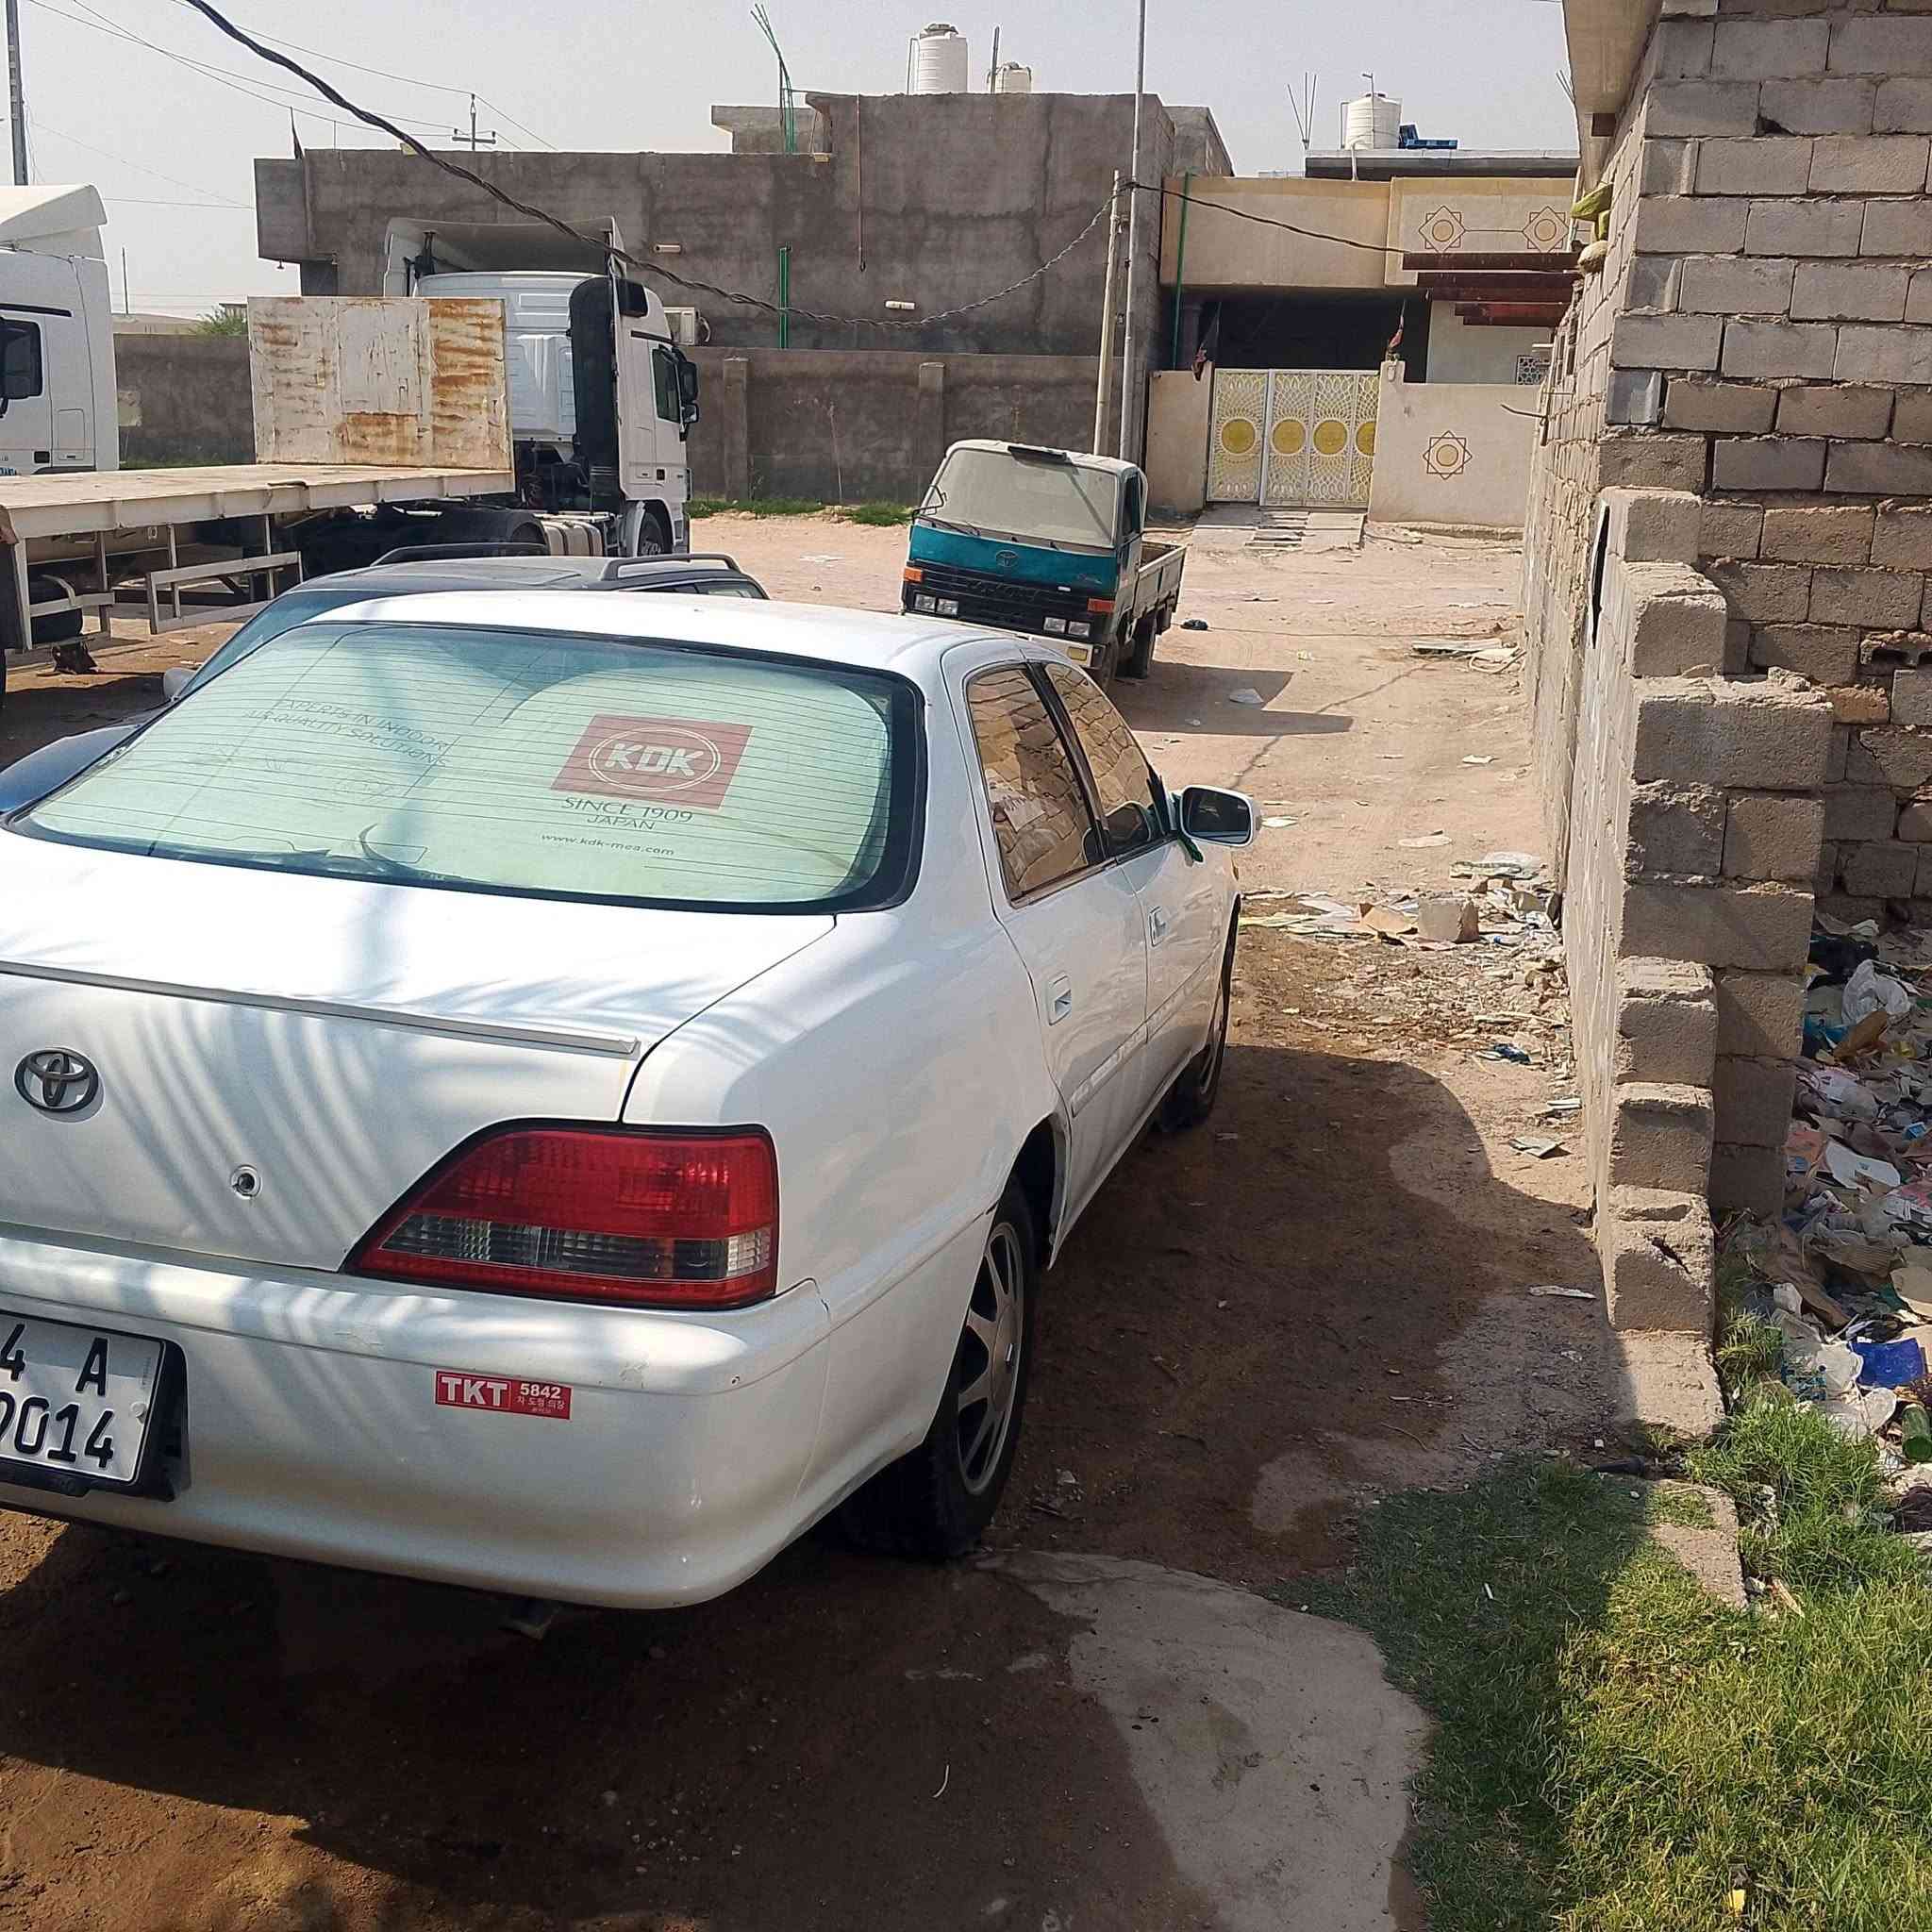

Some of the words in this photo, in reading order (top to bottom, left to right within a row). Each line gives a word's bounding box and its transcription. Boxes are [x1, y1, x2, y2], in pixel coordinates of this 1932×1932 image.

[604, 742, 705, 777] KDK
[560, 797, 632, 817] SINCE
[642, 806, 694, 824] 1909
[587, 814, 657, 831] JAPAN
[541, 832, 675, 857] www.kdk-mea.com
[75, 1337, 109, 1397] A
[441, 1376, 508, 1407] TKT
[520, 1383, 561, 1400] 5842
